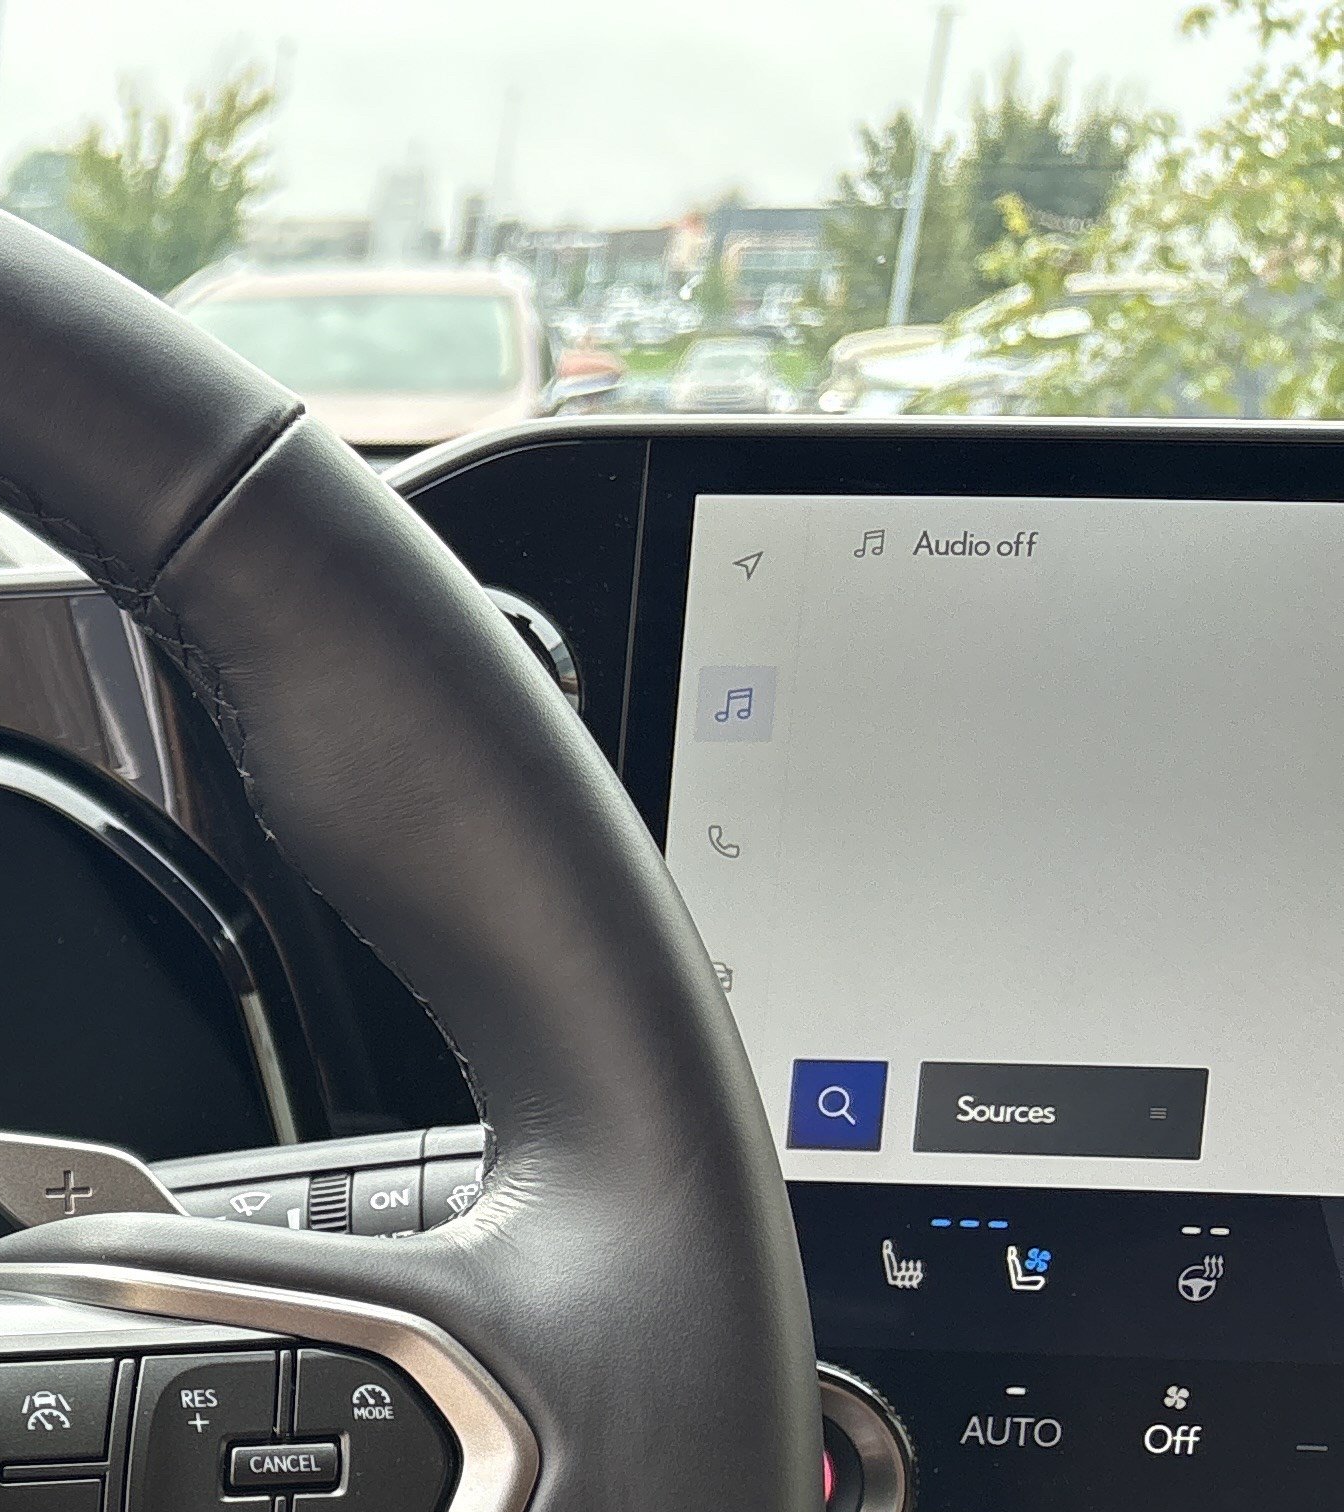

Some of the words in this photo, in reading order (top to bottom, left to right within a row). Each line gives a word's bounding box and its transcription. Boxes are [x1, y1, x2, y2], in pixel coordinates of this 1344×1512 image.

[912, 530, 991, 556] Audio
[996, 531, 1039, 557] off
[956, 1095, 1056, 1125] Sources
[370, 1188, 410, 1210] ON
[180, 1389, 218, 1409] RES
[353, 1406, 395, 1420] MODE
[959, 1416, 1063, 1448] AUTO
[1143, 1424, 1203, 1456] Off
[249, 1454, 322, 1474] CANCEL
